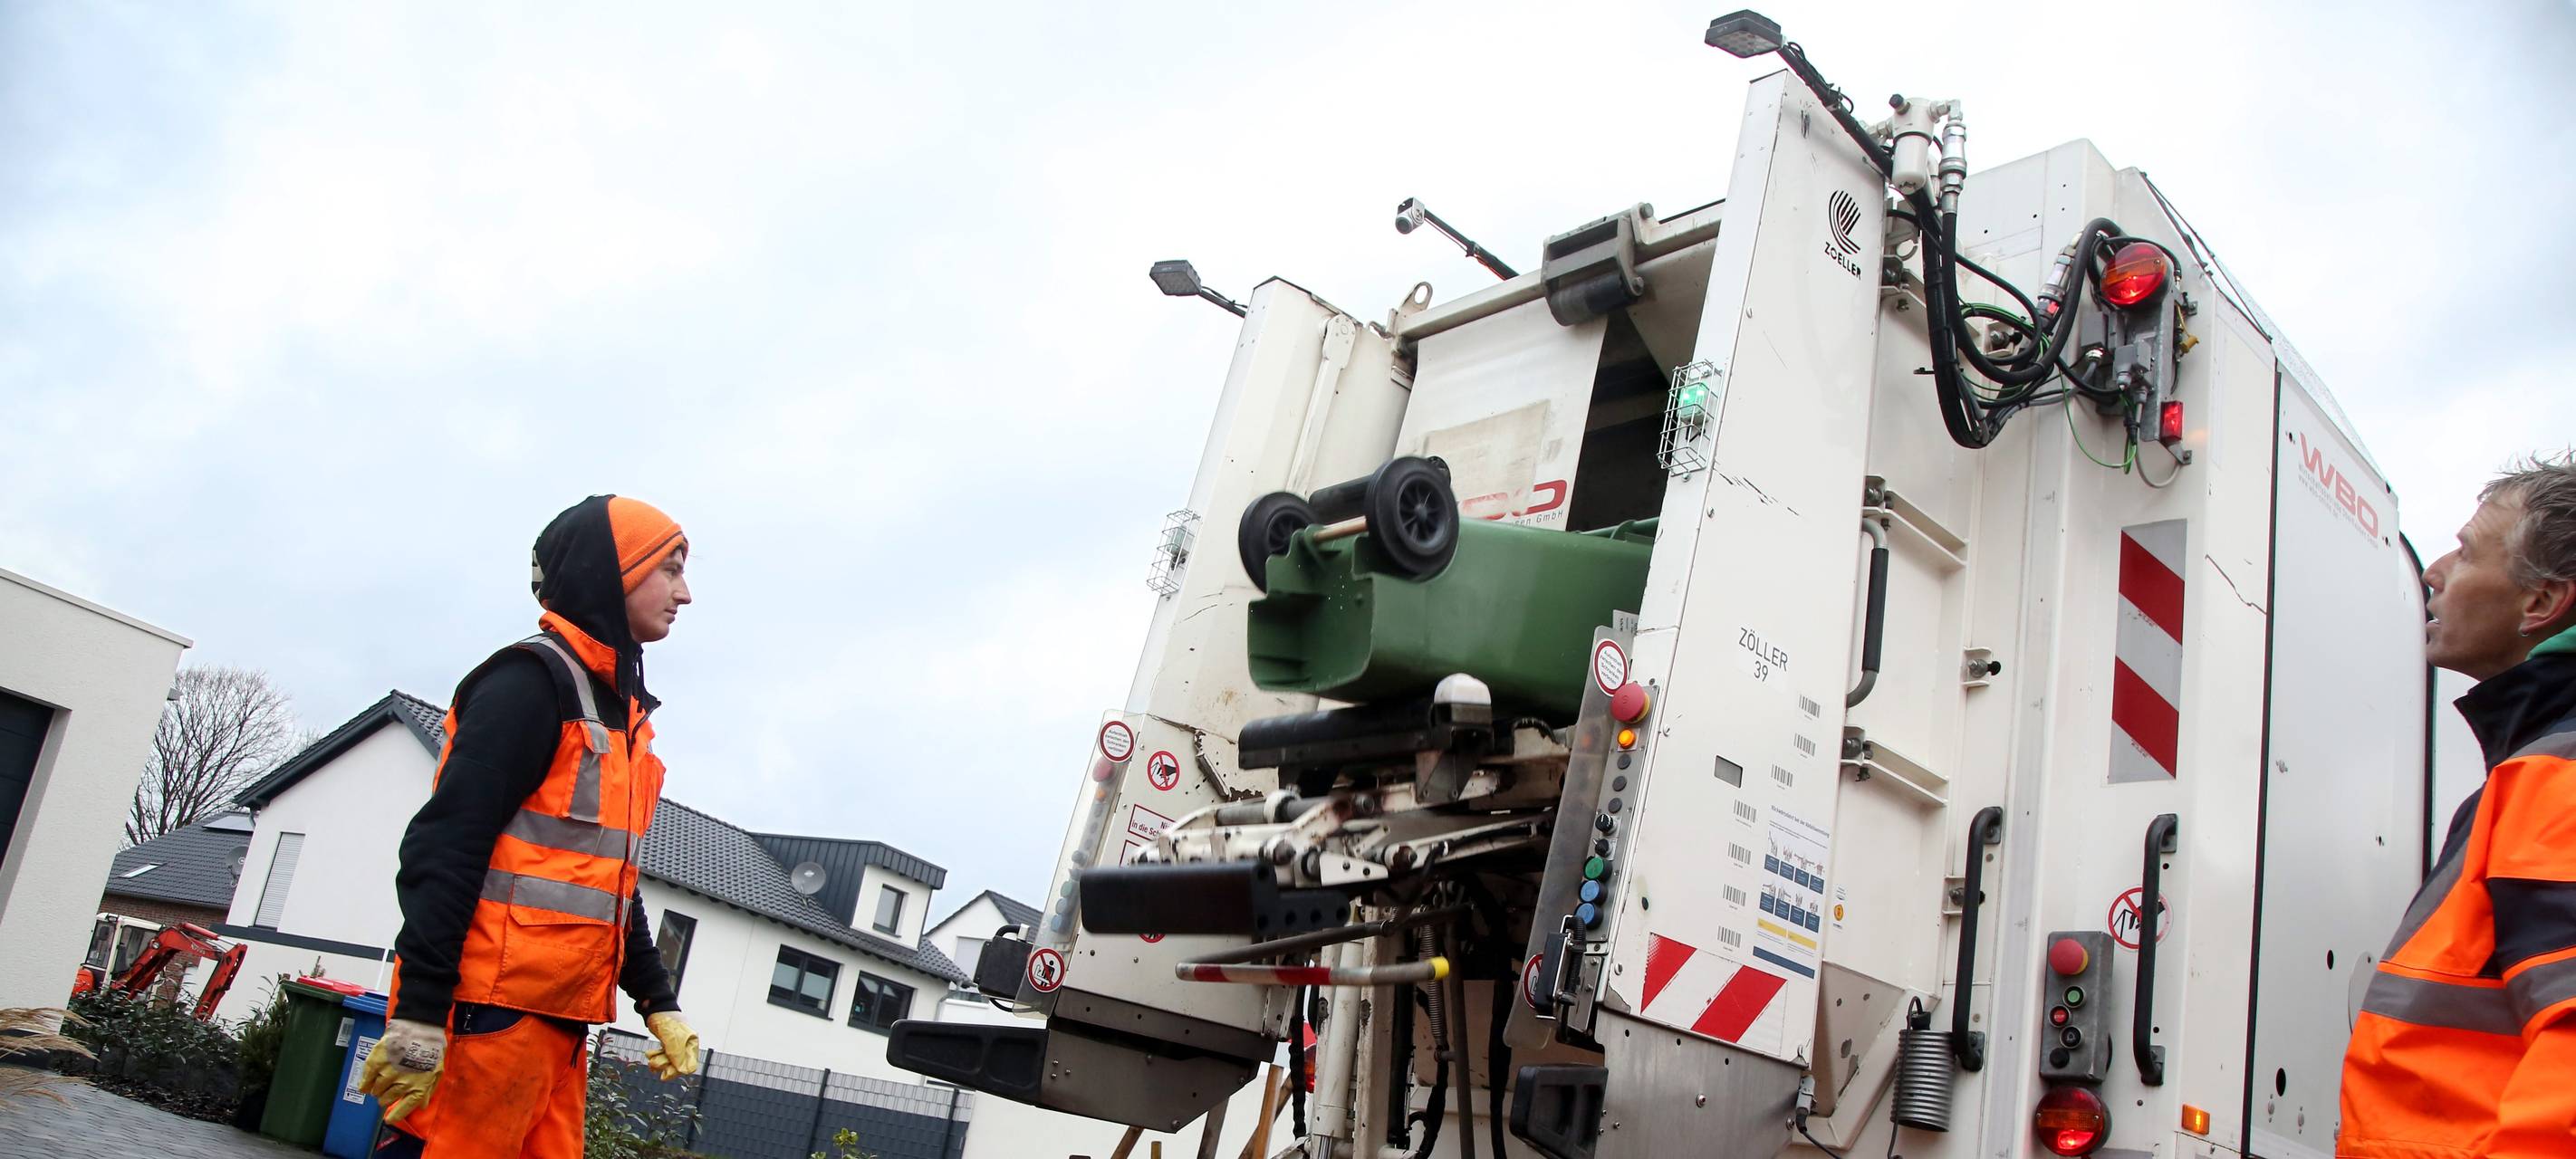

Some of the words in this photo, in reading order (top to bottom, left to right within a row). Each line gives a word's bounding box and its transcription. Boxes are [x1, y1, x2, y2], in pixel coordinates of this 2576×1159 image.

[1824, 241, 1861, 281] ZOELLER
[2299, 431, 2379, 539] WBO
[1536, 510, 1562, 523] GmbH
[1738, 627, 1788, 672] ZÖLLER
[1754, 660, 1769, 682] 39
[1139, 823, 1149, 833] die
